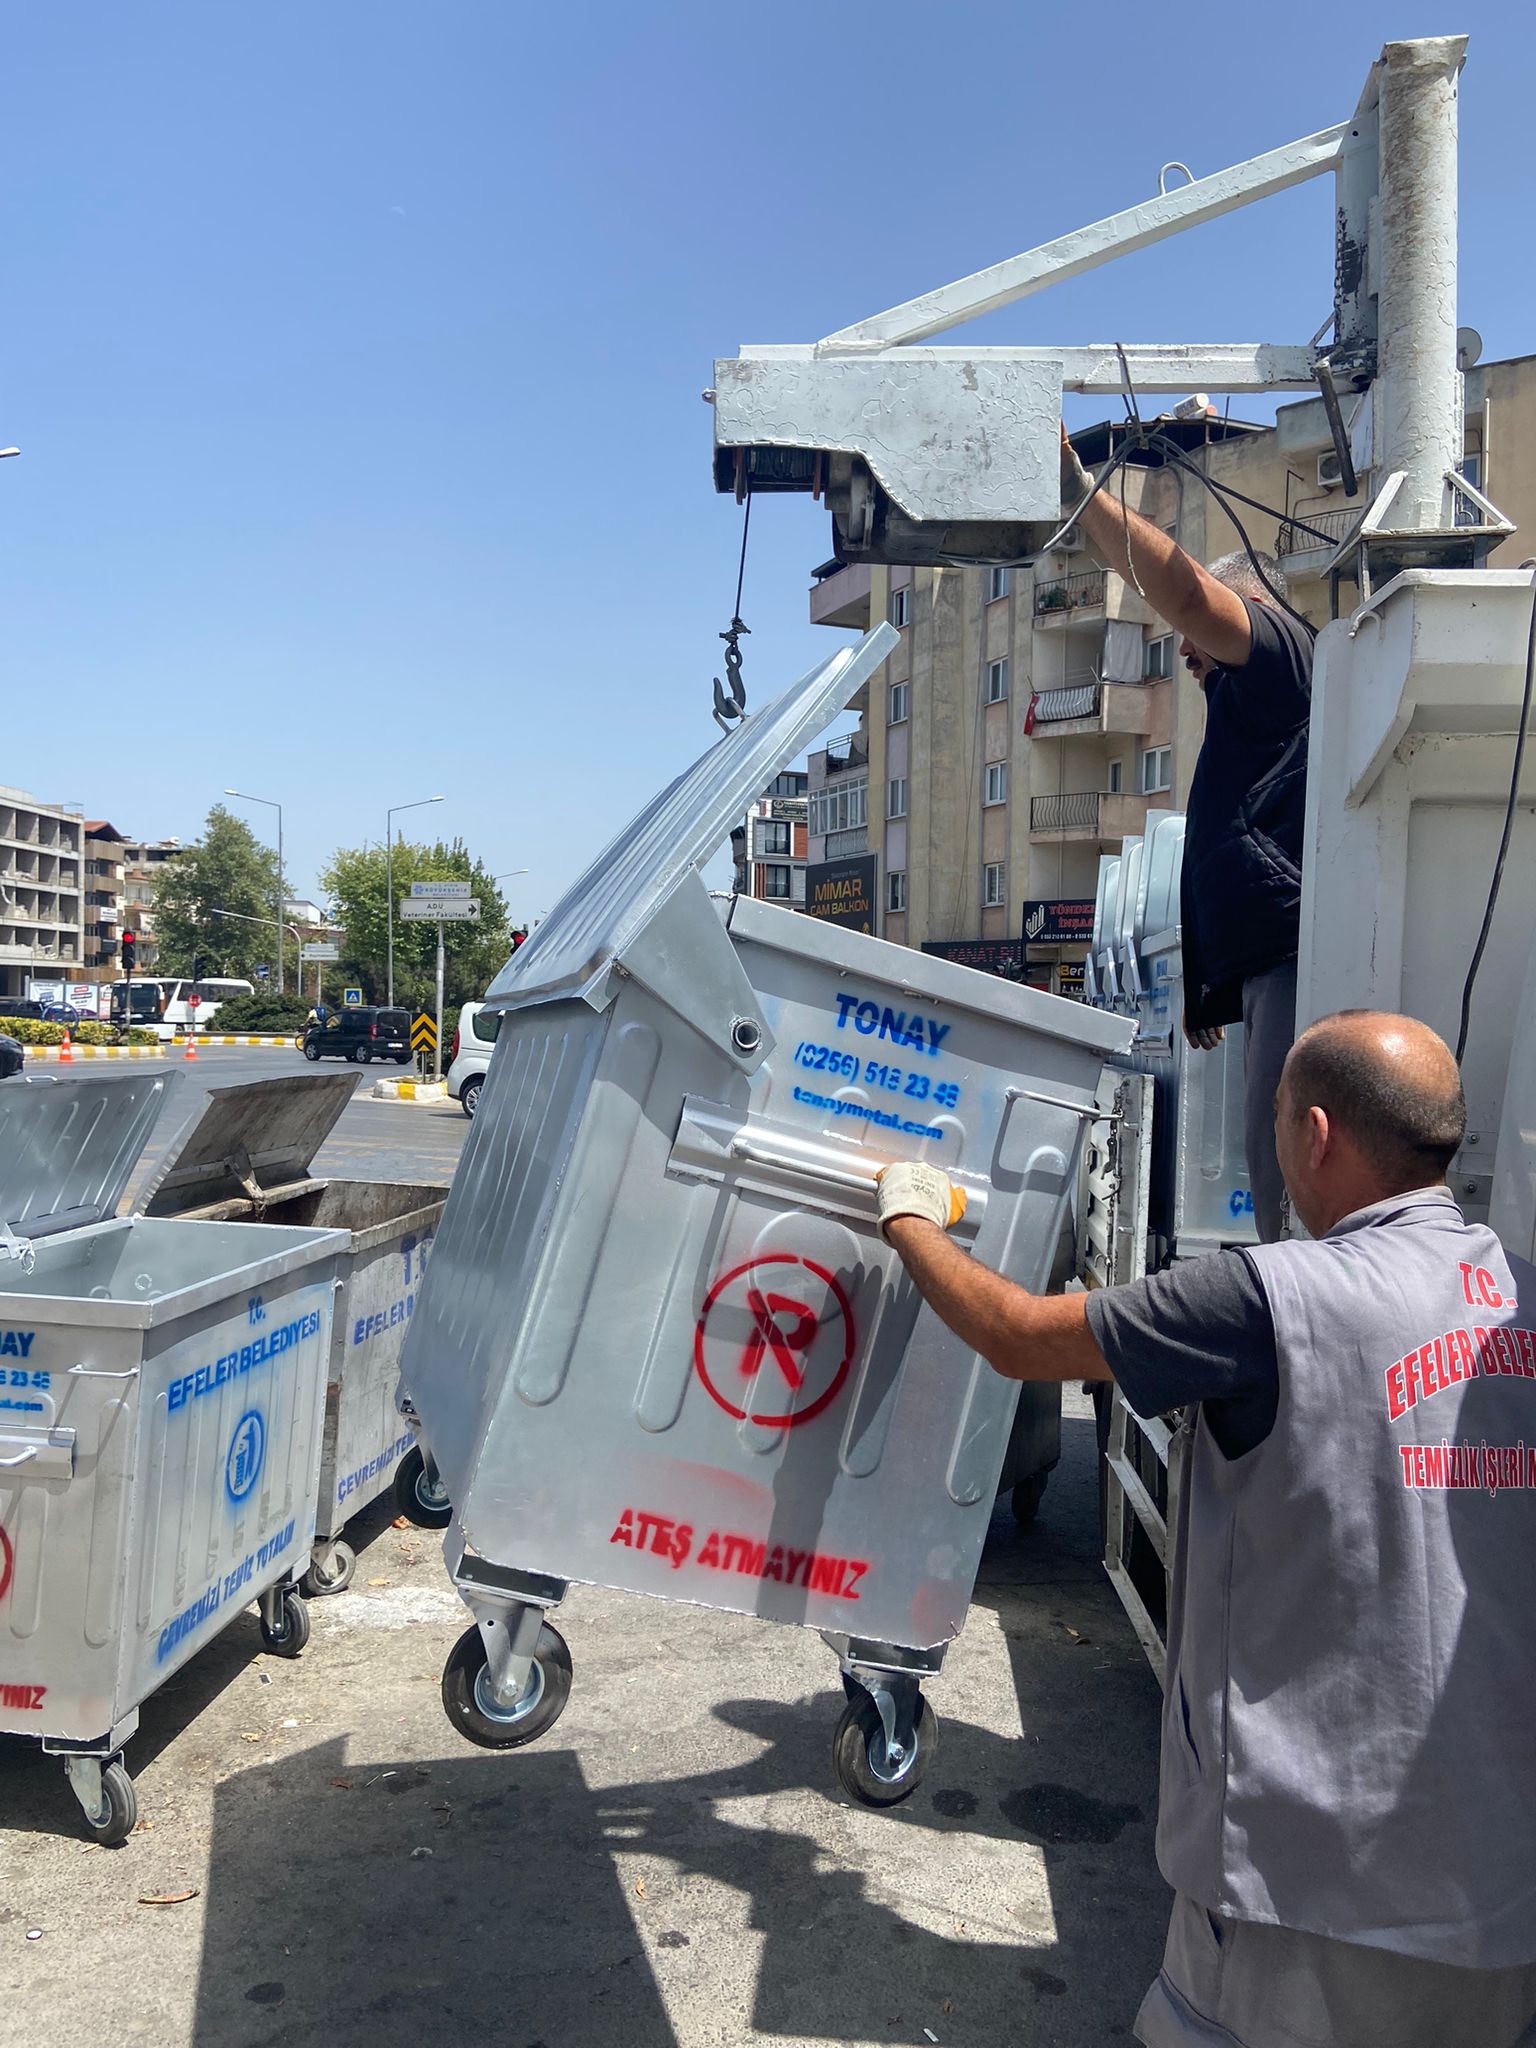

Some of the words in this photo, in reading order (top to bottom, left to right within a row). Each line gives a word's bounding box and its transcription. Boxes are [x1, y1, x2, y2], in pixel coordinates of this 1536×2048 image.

[810, 903, 830, 916] CAM
[831, 899, 869, 915] BALKON
[815, 879, 862, 902] MİMAR
[836, 993, 951, 1056] TONAY
[794, 1042, 860, 1083] (0256)
[903, 1073, 931, 1099] 23
[1457, 1260, 1518, 1309] T.C.
[0, 1331, 36, 1357] AY
[354, 1299, 405, 1346] EFELER
[11, 1371, 28, 1387] 23
[168, 1351, 238, 1412] EFELER
[1385, 1328, 1480, 1424] EFELER
[1471, 1325, 1536, 1380] BELE
[1400, 1438, 1481, 1489] TEMİZLİK
[1481, 1439, 1524, 1498] İŞLERİ
[609, 1509, 694, 1569] ATEŞ
[697, 1532, 869, 1600] ATMAYINIZ
